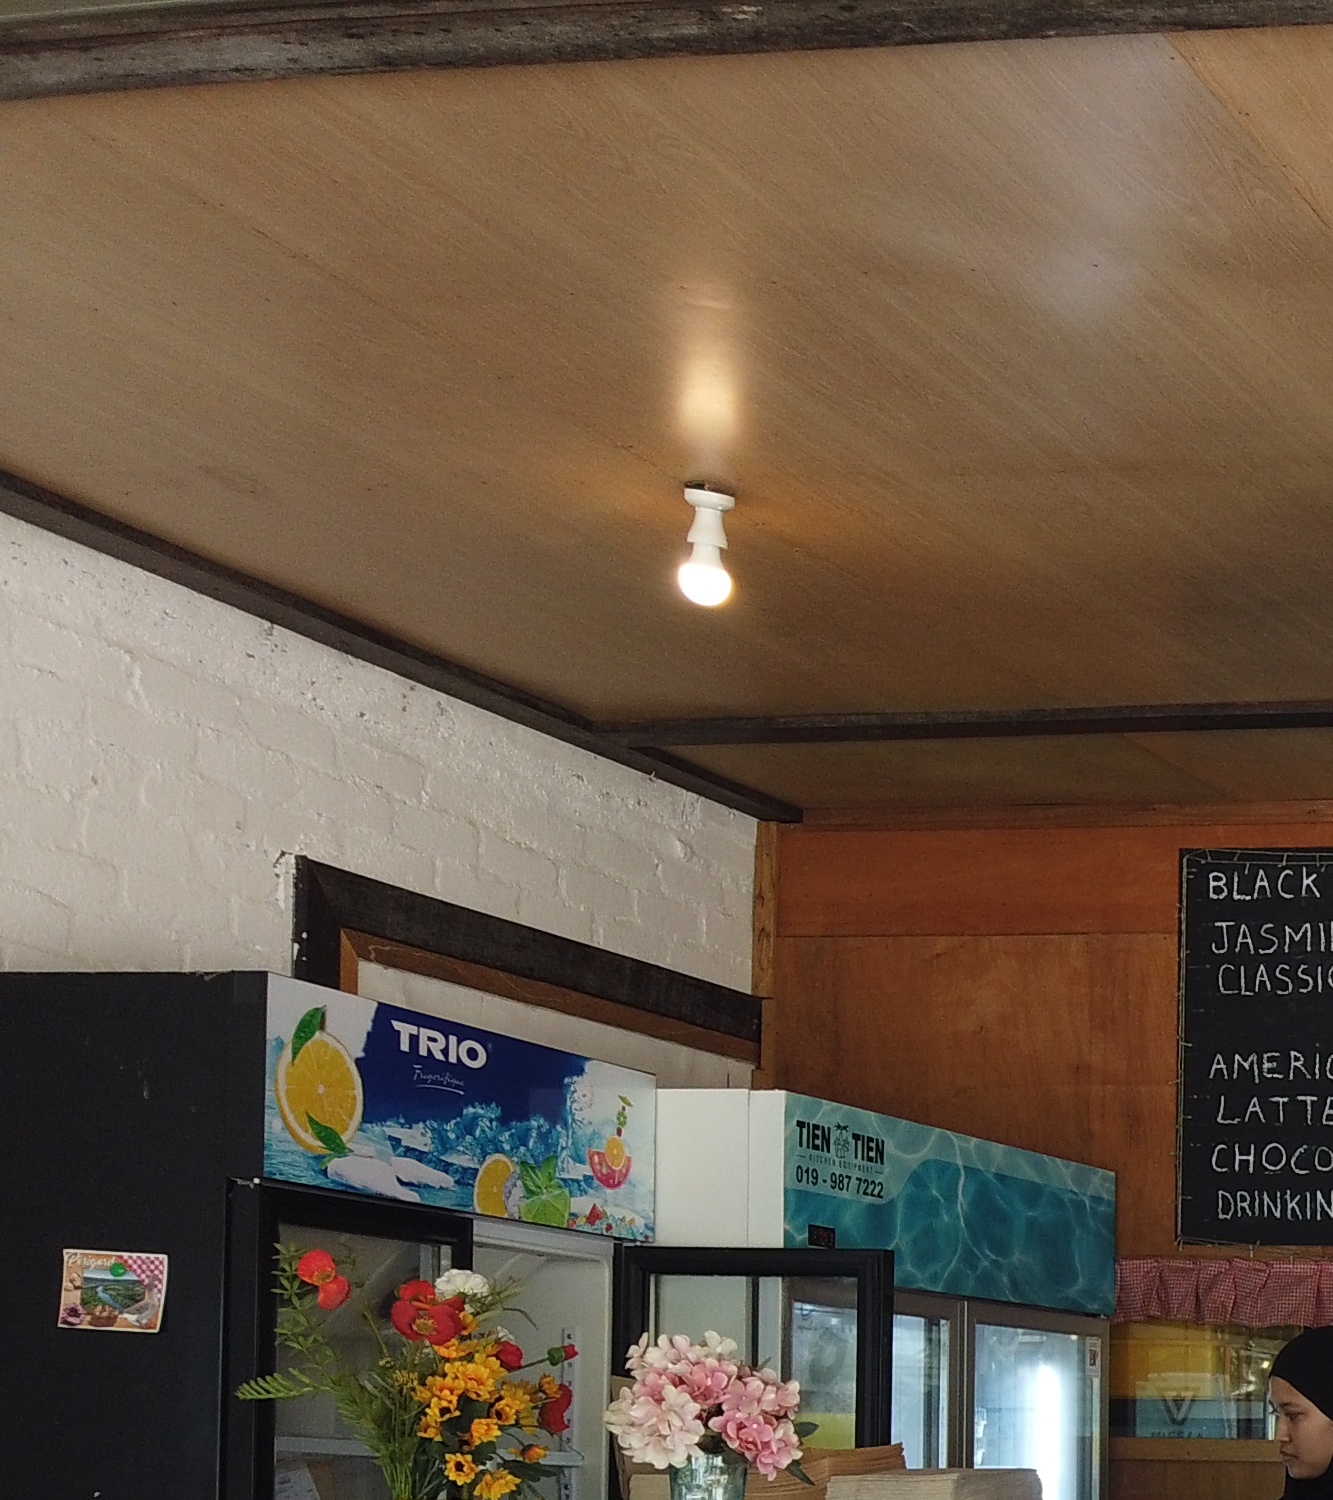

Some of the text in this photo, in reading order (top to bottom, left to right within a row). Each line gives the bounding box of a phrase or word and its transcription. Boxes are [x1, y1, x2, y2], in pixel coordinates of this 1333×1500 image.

[1207, 866, 1321, 900] BLACK
[390, 1019, 487, 1069] TRIO
[796, 1119, 885, 1165] TIEN TIEN
[795, 1164, 819, 1187] 019
[830, 1171, 852, 1193] 987
[855, 1176, 884, 1199] 7222
